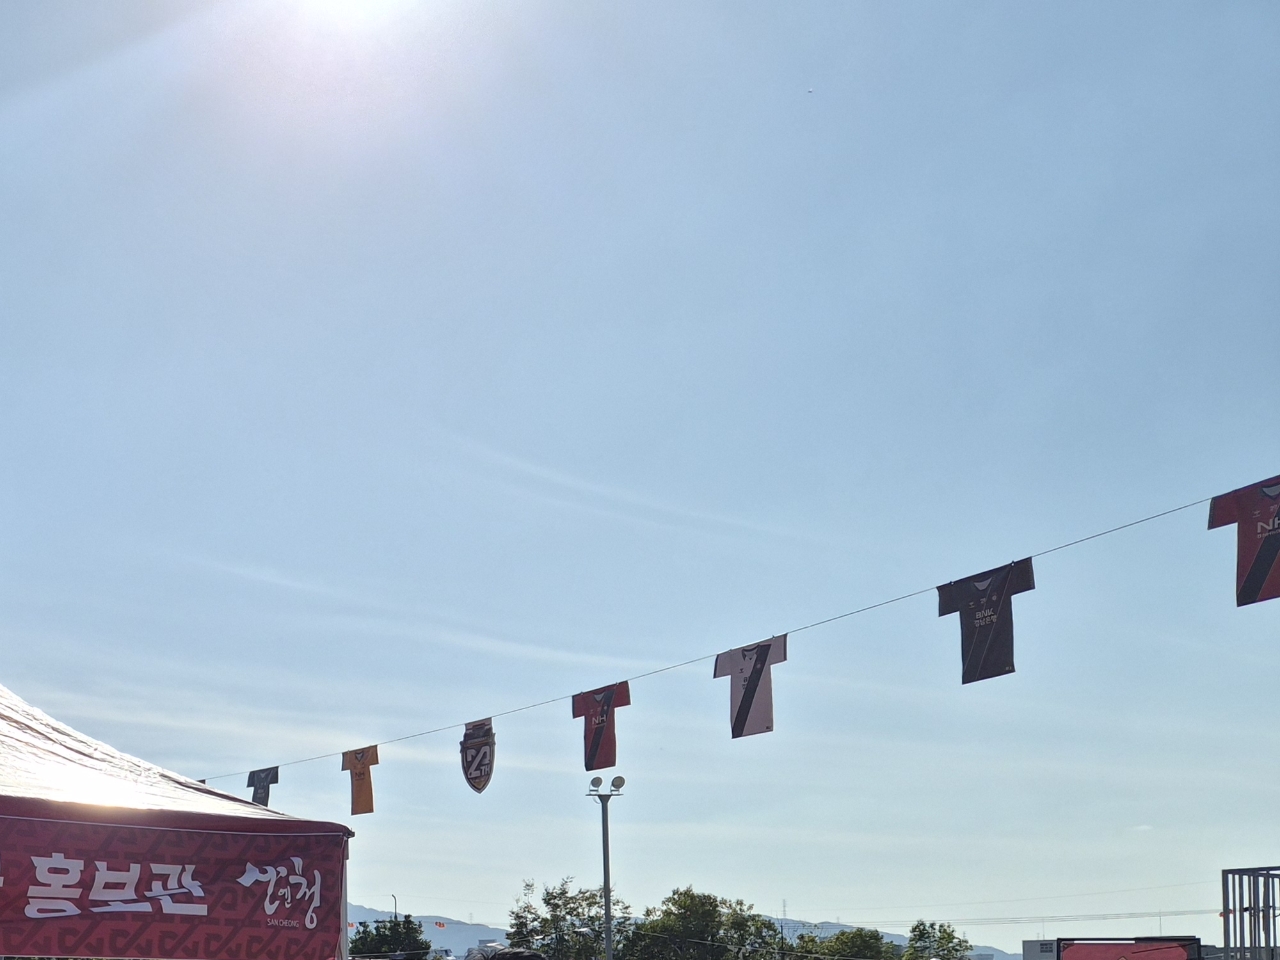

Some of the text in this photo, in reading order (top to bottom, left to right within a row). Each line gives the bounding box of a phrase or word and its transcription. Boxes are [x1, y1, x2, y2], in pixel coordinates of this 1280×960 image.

[592, 714, 607, 725] NH
[24, 852, 208, 919] 홍보관
[267, 918, 300, 928] SAN CHEONG
